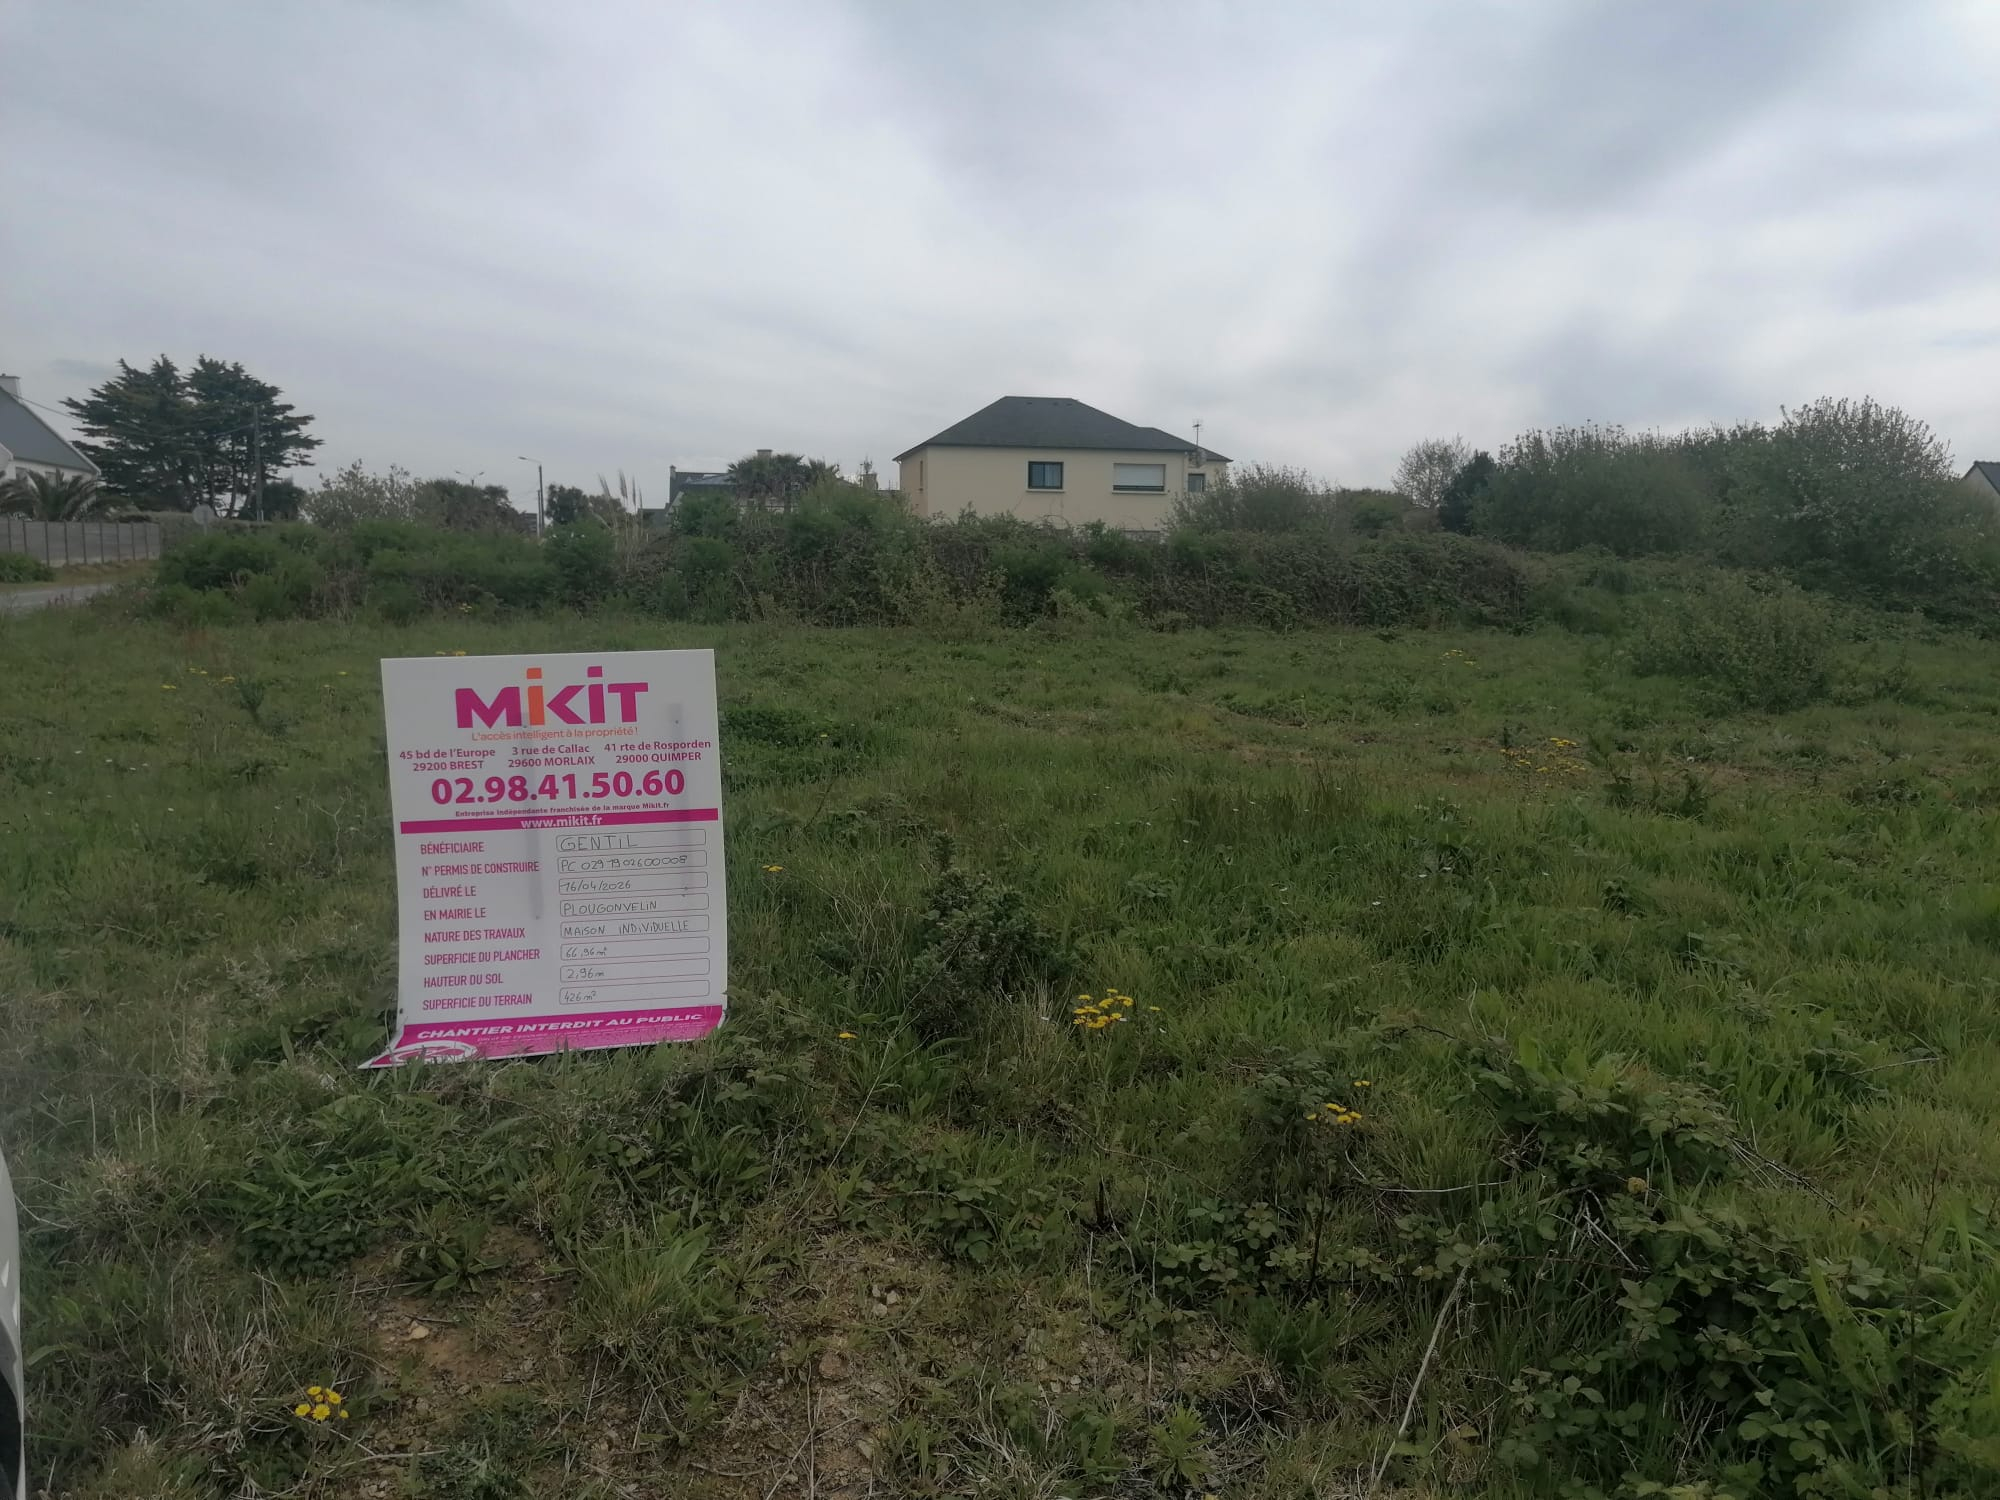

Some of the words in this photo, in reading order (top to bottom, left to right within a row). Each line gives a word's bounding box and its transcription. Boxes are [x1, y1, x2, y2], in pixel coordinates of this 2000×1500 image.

[472, 731, 511, 741] L'accès
[513, 729, 563, 740] intelligent
[566, 728, 572, 737] à
[574, 728, 583, 738] la
[512, 747, 518, 755] 3
[521, 747, 539, 755] rue
[542, 745, 556, 754] de
[558, 744, 590, 754] Callac
[604, 743, 616, 752] 41
[620, 743, 636, 751] rte
[638, 741, 651, 750] de
[654, 739, 711, 751] Rosporden
[400, 751, 414, 760] 45
[416, 749, 430, 759] bd
[433, 749, 447, 758] de
[450, 747, 496, 759] l'Europe
[616, 754, 649, 763] 29000
[651, 752, 702, 762] QUIMPER
[413, 761, 446, 772] 29200
[450, 760, 484, 770] BREST
[508, 758, 541, 768] 29600
[544, 756, 595, 767] MORLAIX
[431, 769, 685, 805] 02.98.41.50.60
[455, 810, 494, 818] Entreprise
[612, 804, 640, 812] marque
[520, 815, 602, 829] www.mikit.fr
[420, 840, 485, 855] BÉNÉFICIAIRE
[434, 864, 468, 876] PERMIS
[471, 863, 483, 874] DE
[484, 861, 540, 874] CONSTRUIRE
[561, 859, 577, 871] PC
[423, 884, 462, 899] DÉLIVRÉ
[465, 885, 476, 897] LE
[424, 910, 437, 920] EN
[439, 908, 473, 920] MAIRIE
[475, 907, 487, 918] LE
[424, 931, 461, 943] NATURE
[463, 929, 481, 941] DES
[483, 928, 525, 940] TRAVAUX
[424, 952, 476, 966] SUPERFICIE
[478, 951, 491, 962] DU
[493, 949, 540, 962] PLANCHER
[424, 975, 467, 988] HAUTEUR
[470, 974, 483, 985] DU
[485, 973, 503, 984] SOL
[422, 997, 476, 1010] SUPERFICIE
[478, 996, 491, 1007] DU
[493, 993, 533, 1006] TERRAIN
[417, 1025, 514, 1039] CHANTIER
[516, 1019, 604, 1033] INTERDIT
[606, 1018, 632, 1026] AU
[636, 1013, 703, 1024] PUBLIC
